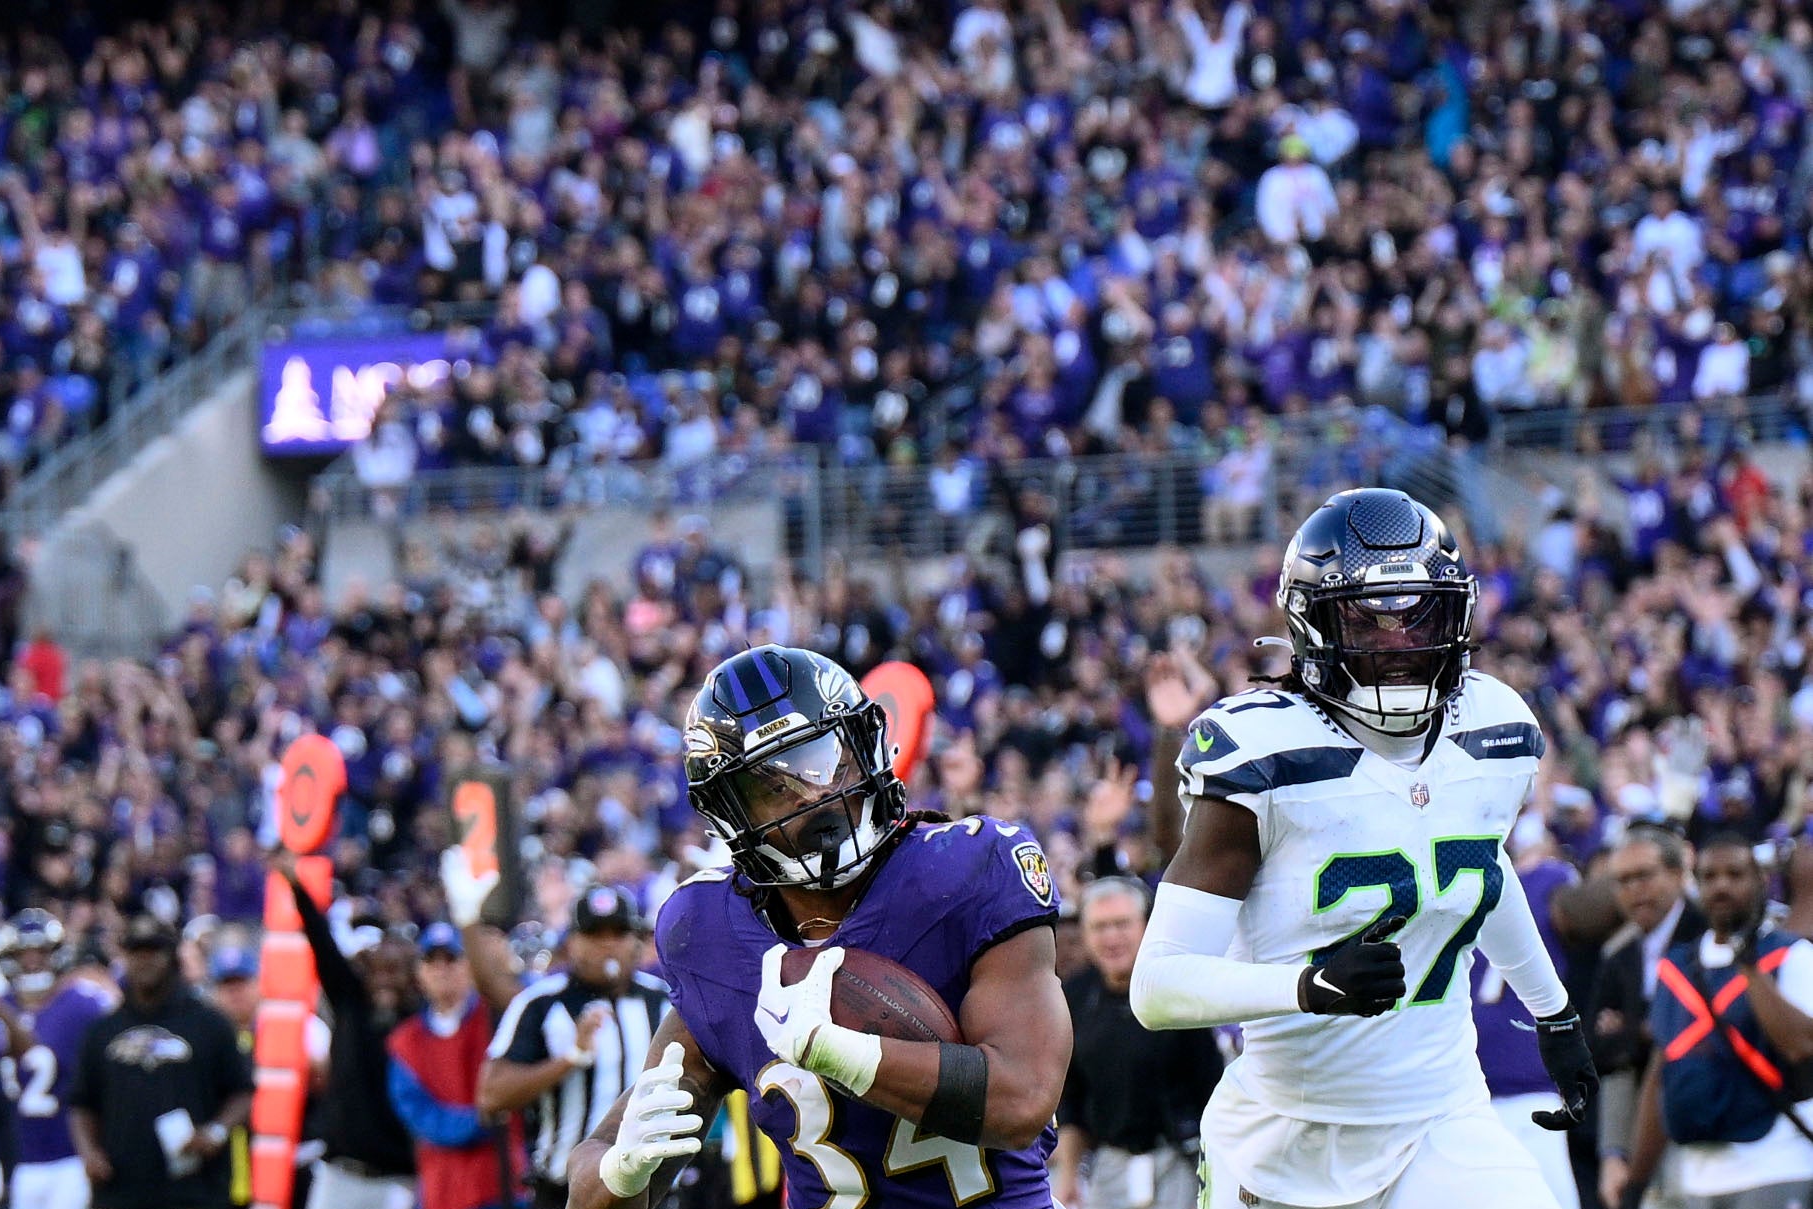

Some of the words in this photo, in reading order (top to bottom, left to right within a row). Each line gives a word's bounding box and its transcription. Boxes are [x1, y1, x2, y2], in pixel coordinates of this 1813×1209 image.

[756, 717, 791, 739] RAVENS
[1306, 834, 1513, 1011] 27
[866, 985, 909, 1017] FOOTBALL
